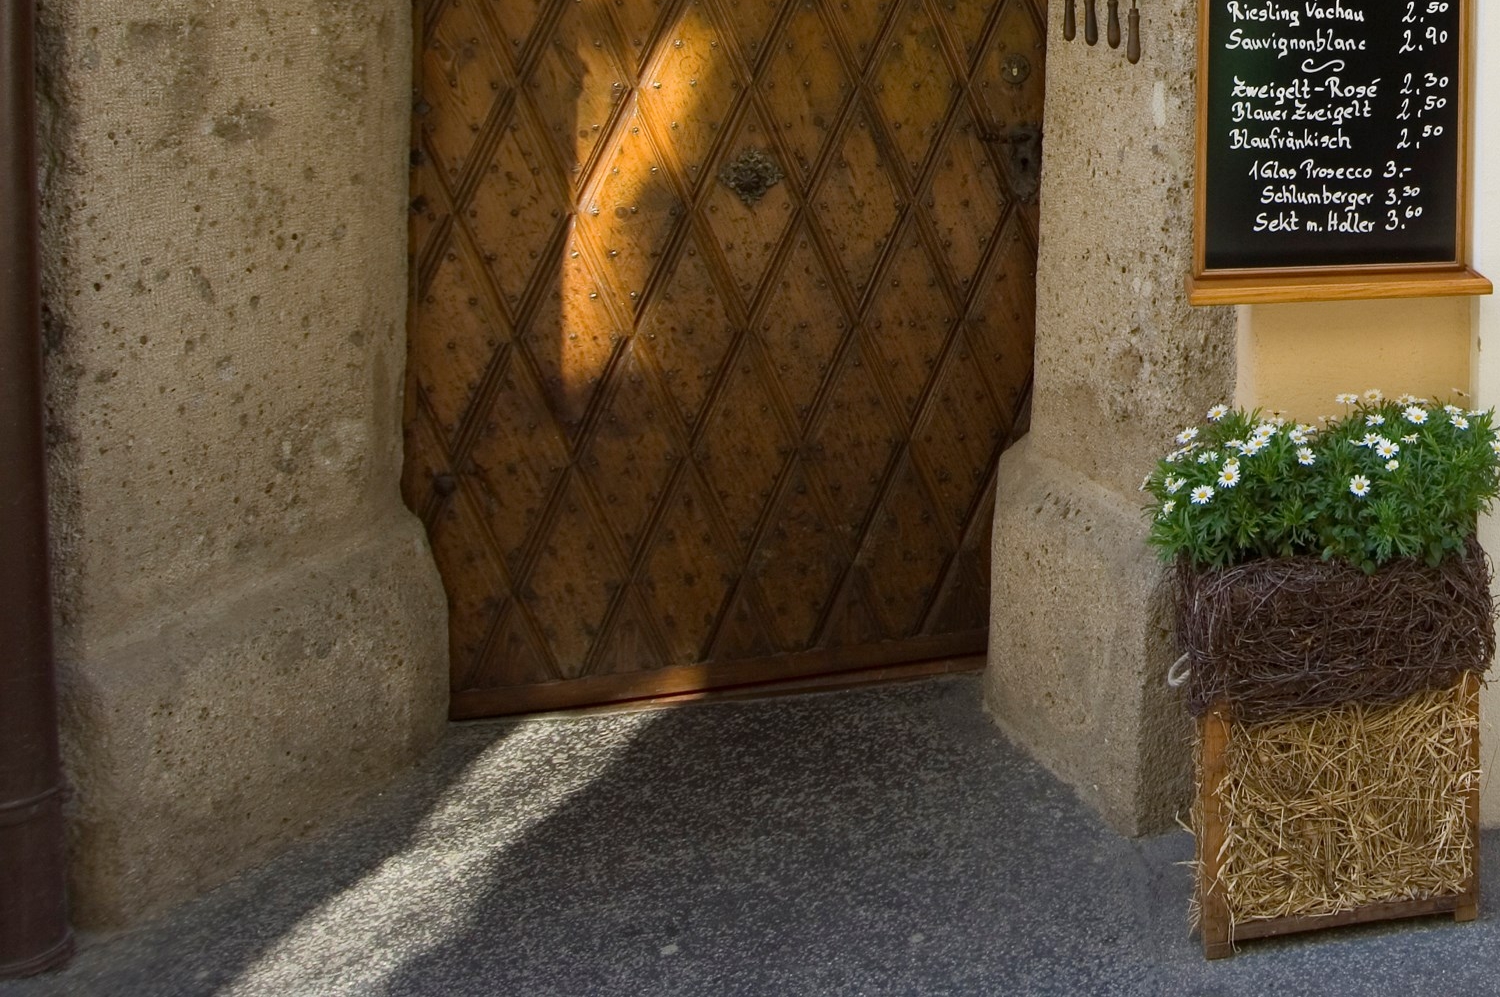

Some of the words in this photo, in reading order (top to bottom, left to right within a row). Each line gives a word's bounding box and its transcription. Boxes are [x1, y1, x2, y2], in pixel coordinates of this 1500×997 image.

[1227, 1, 1300, 27] Riesling
[1232, 101, 1288, 122] Blauer
[1291, 100, 1372, 126] Zweigelt
[1229, 126, 1351, 150] Blaufränkisch
[1248, 160, 1258, 180] 1
[1260, 161, 1297, 180] Glas
[1300, 159, 1372, 179] Prosecco
[1260, 185, 1374, 213] Schlumberger
[1253, 212, 1300, 232] Sekt
[1307, 220, 1323, 232] m.
[1328, 210, 1375, 233] Holler
